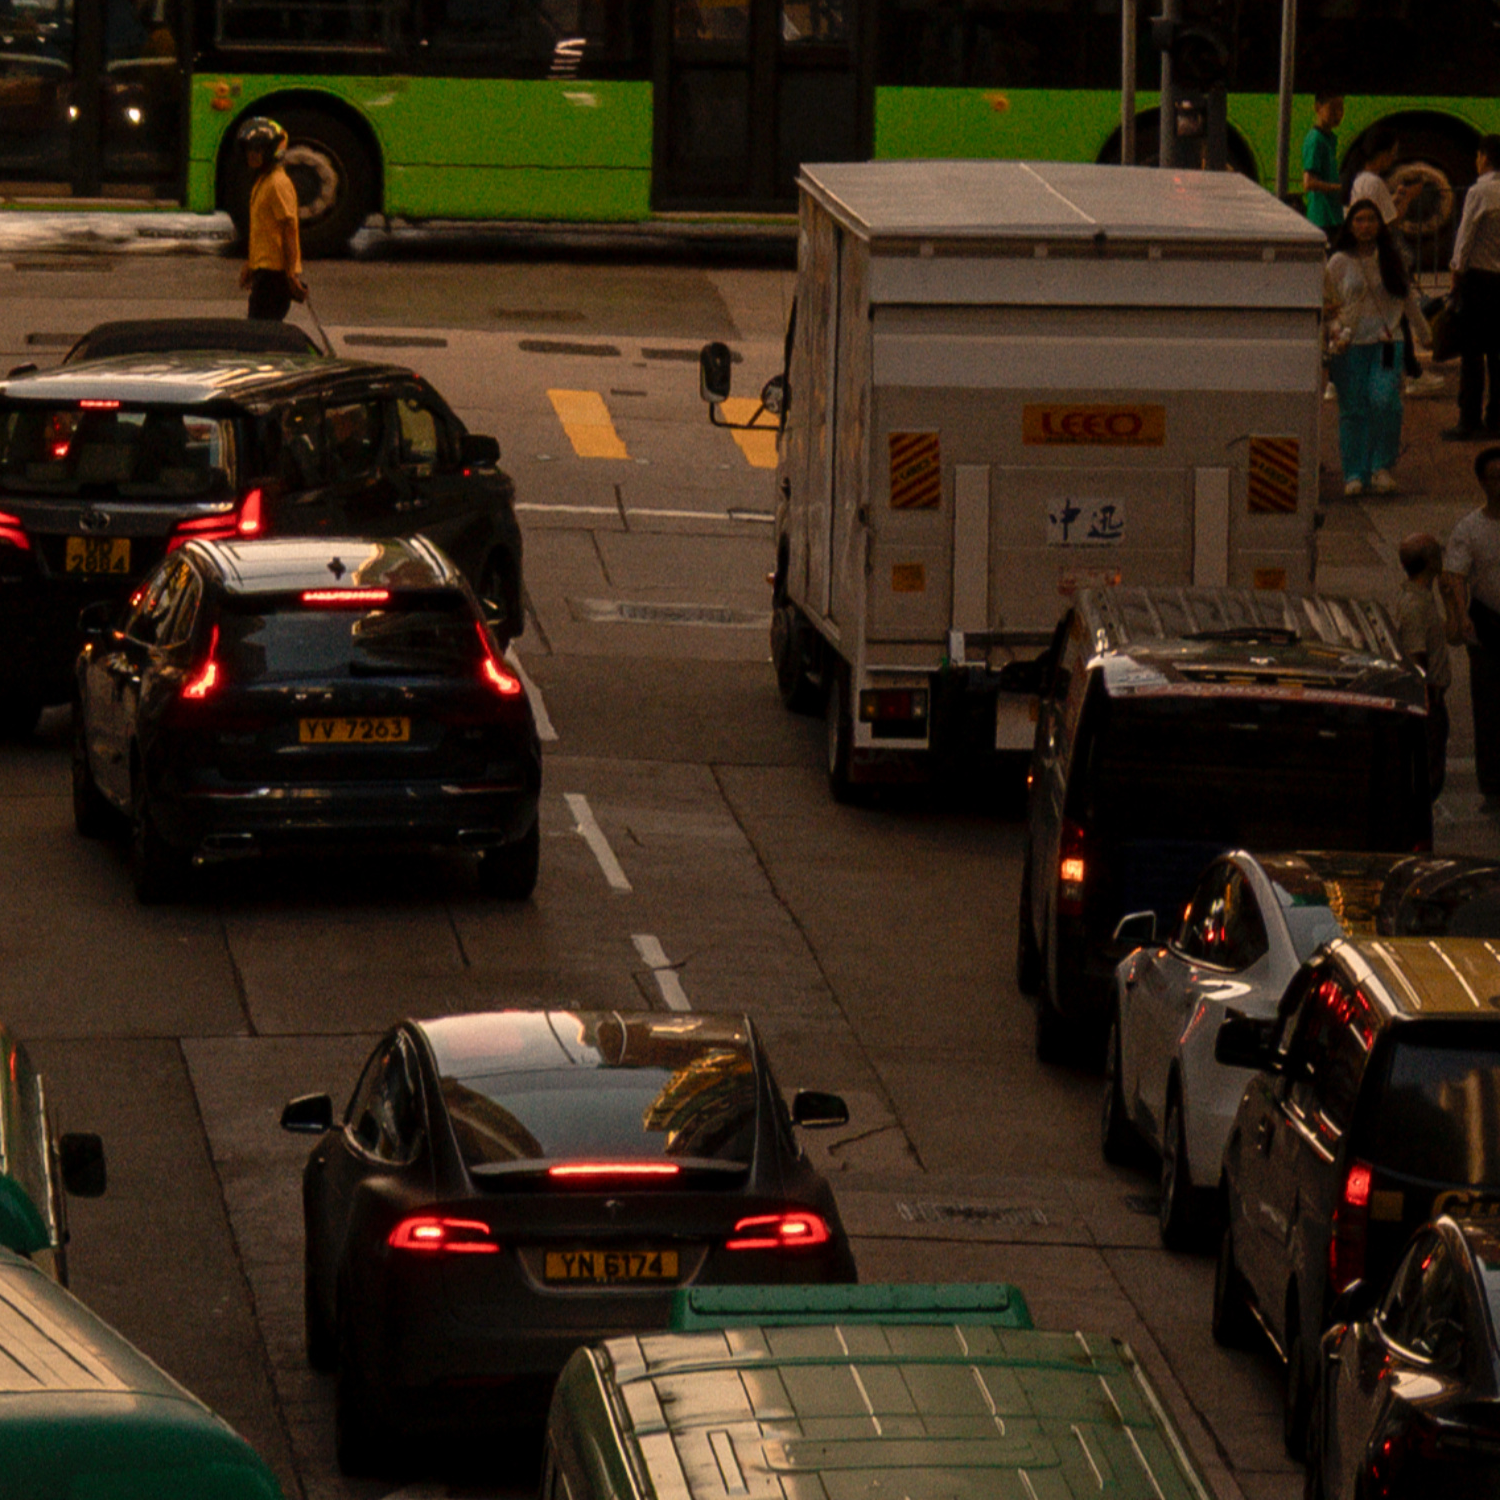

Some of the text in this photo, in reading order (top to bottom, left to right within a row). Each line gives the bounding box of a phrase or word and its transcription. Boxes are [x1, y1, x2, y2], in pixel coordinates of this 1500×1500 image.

[306, 719, 403, 739] YV 7263
[561, 1253, 662, 1276] YN 6174
